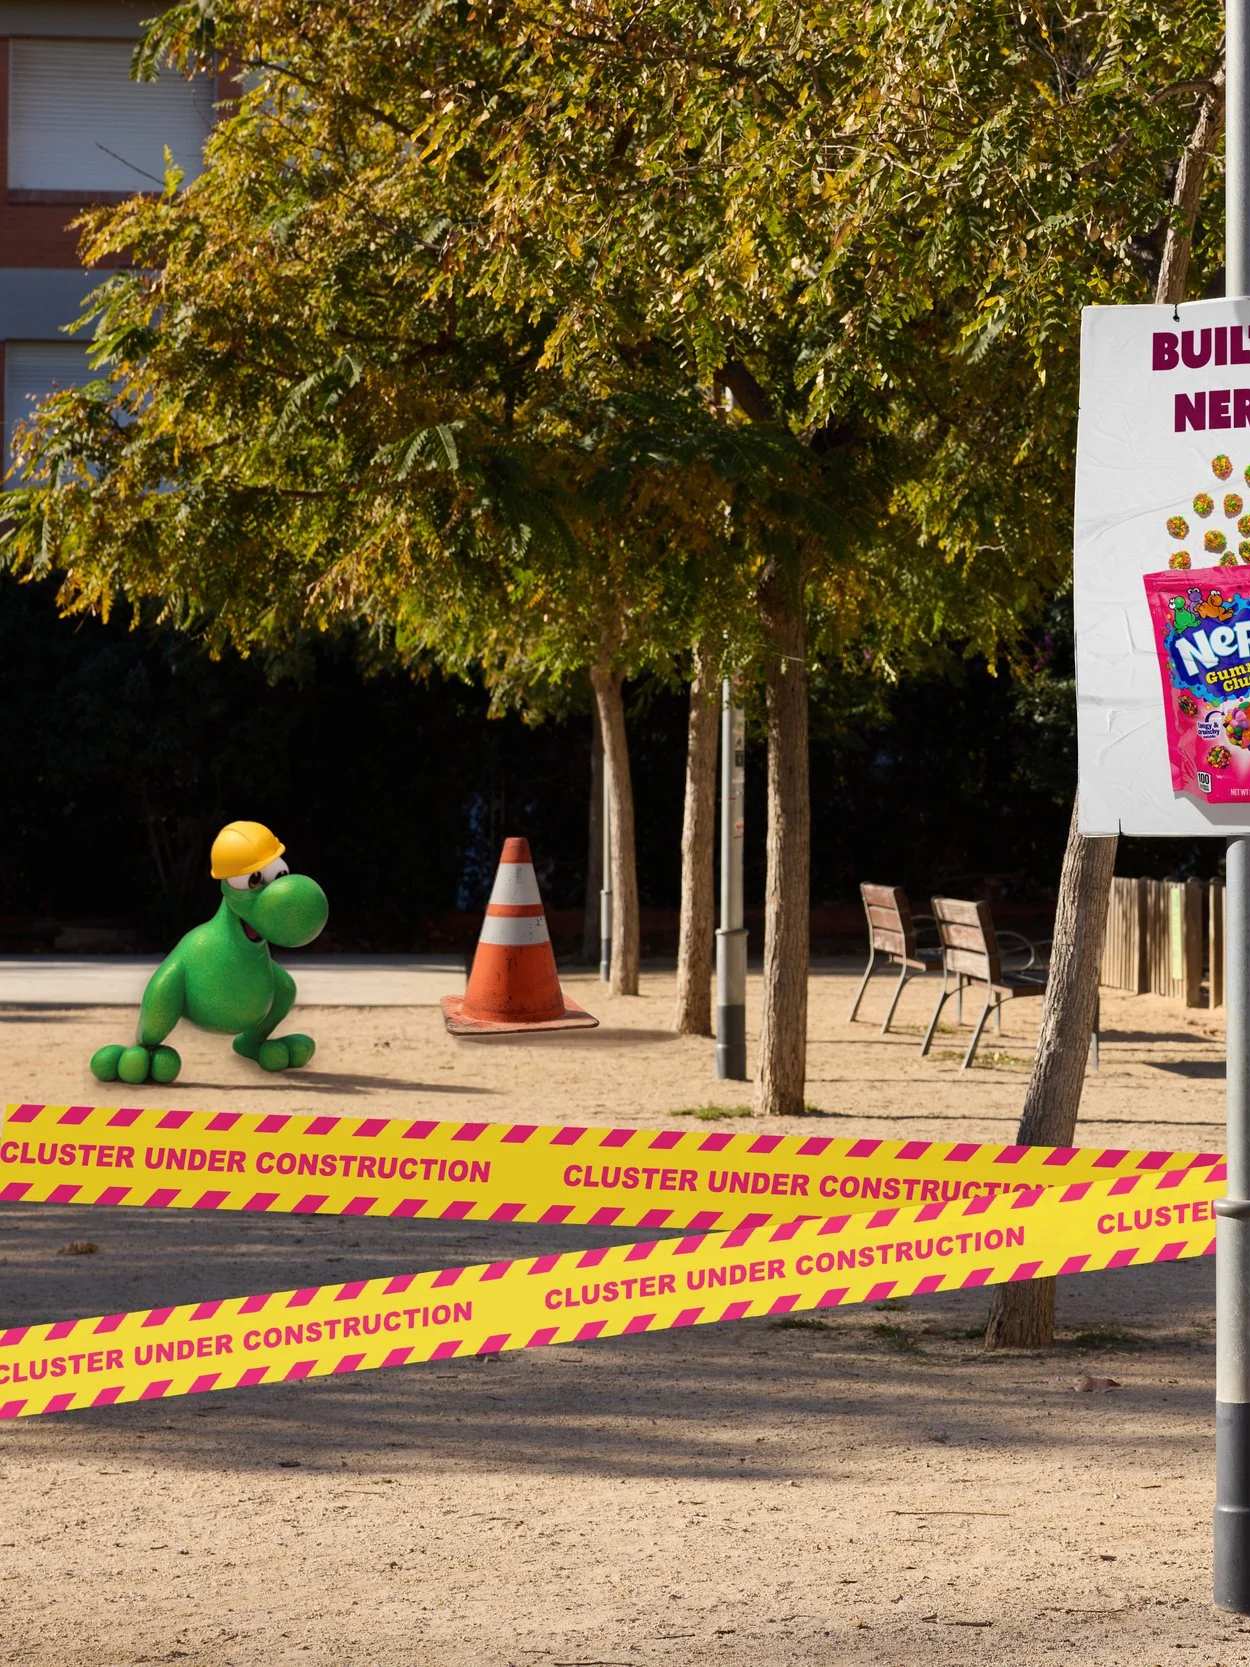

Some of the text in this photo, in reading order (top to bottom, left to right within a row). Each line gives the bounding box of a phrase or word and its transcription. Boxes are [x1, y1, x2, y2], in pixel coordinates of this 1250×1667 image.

[1197, 772, 1210, 785] 100
[1230, 788, 1240, 796] NET
[1240, 788, 1249, 796] WT
[0, 1141, 492, 1184] CLUSTER UNDER CONSTRUCTION
[563, 1164, 1054, 1204] CLUSTER UNDER CONSTRUCT
[545, 1225, 1025, 1310] CLUSTER UNDER CONSTRUCTION
[0, 1301, 472, 1385] CLUSTER UNDER CONSTRUCTION
